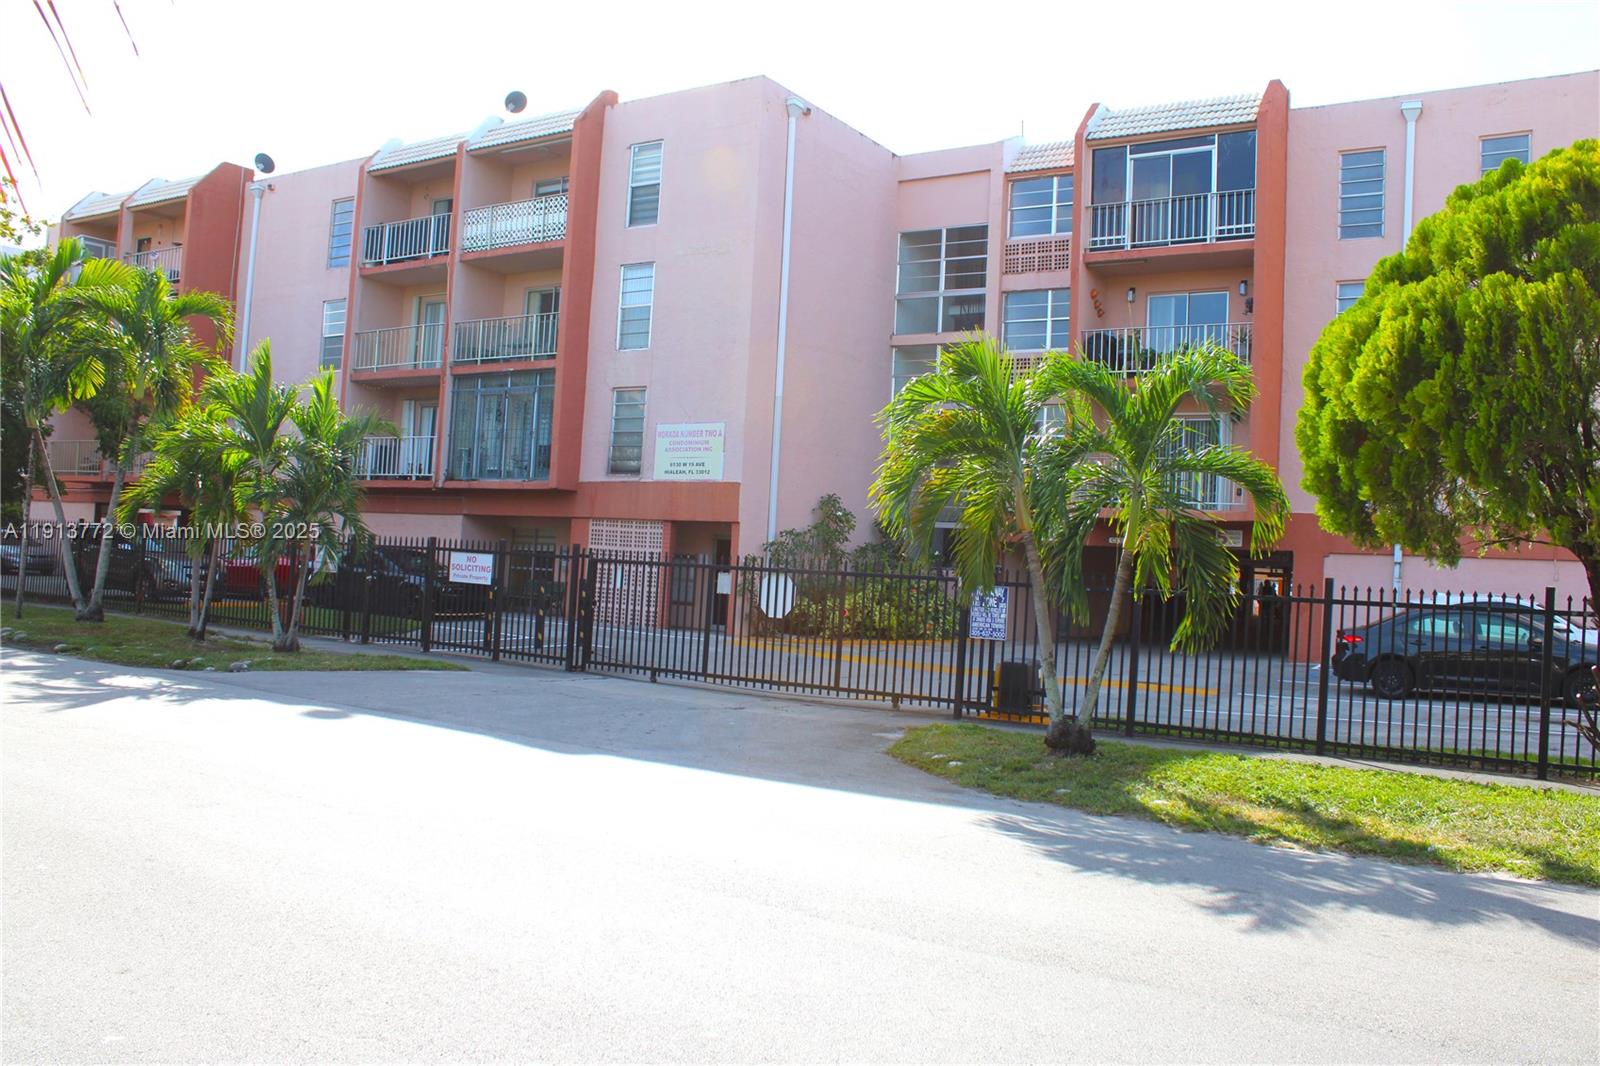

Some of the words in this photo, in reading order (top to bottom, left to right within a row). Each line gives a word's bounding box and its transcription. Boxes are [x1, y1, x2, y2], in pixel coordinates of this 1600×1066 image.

[680, 430, 704, 438] NUMBER
[467, 555, 477, 563] NO
[452, 563, 492, 573] SOLICITING
